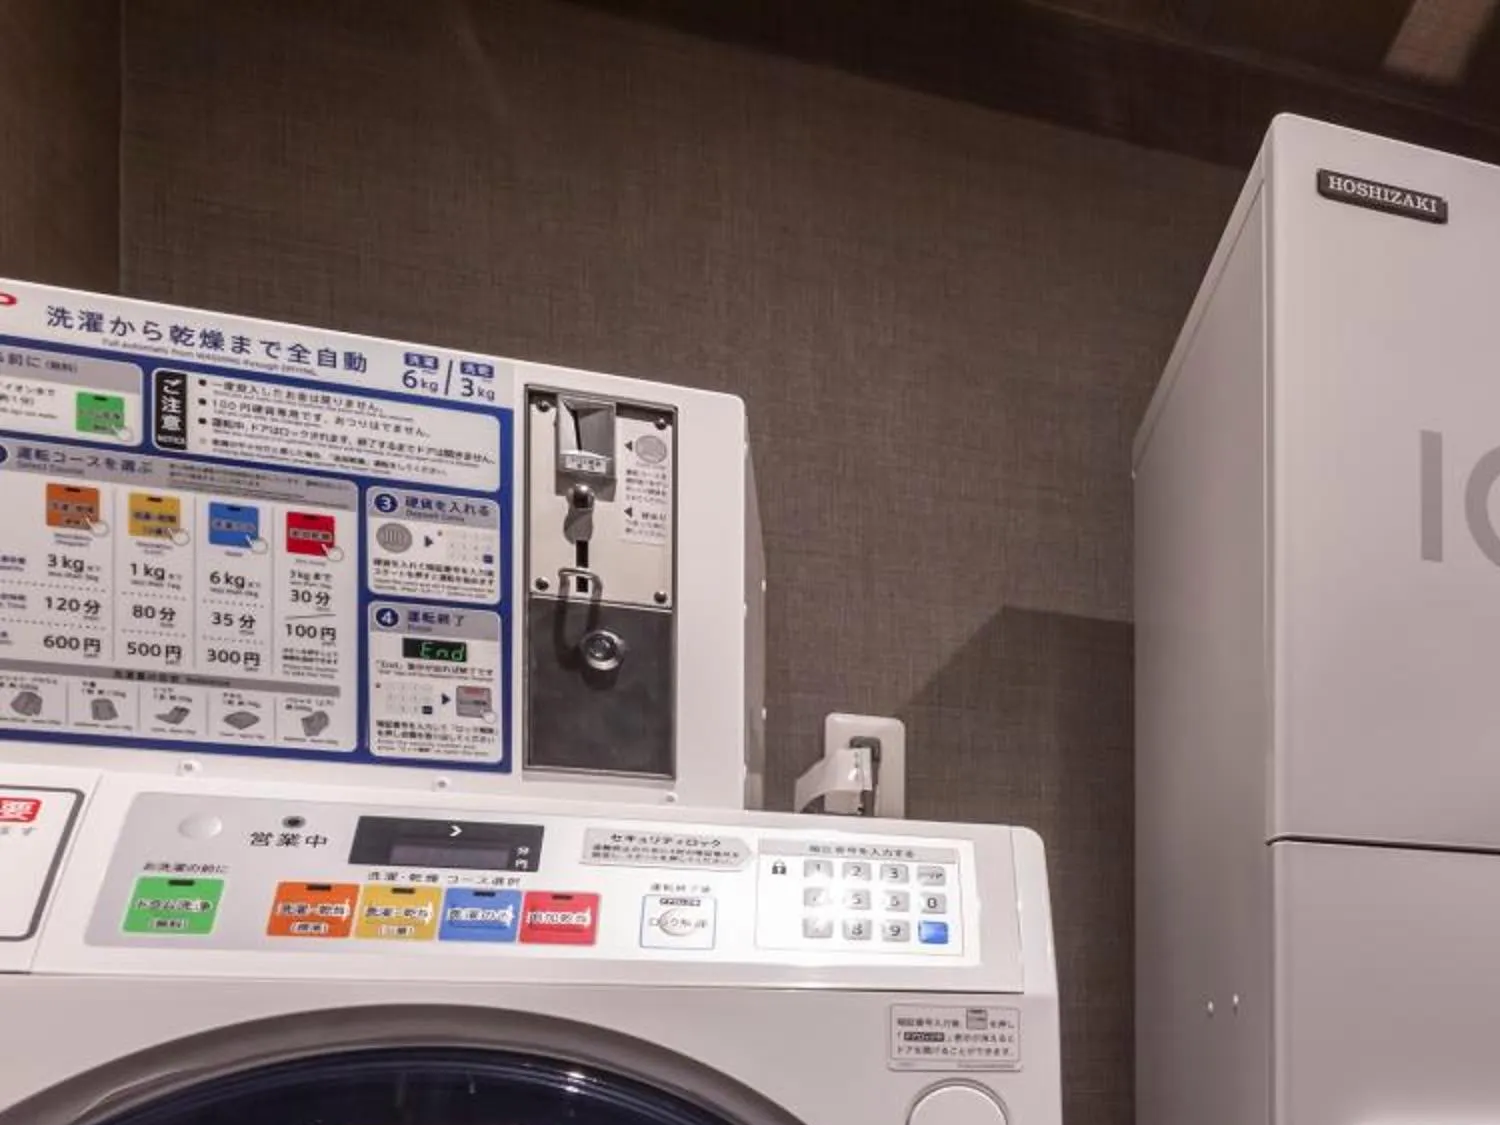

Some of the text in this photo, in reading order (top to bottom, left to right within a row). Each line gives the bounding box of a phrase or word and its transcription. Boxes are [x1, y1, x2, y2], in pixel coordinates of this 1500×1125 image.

[1327, 174, 1438, 214] HOSHIZAKI
[46, 304, 368, 374] 洗濯から乾燥まで全自動
[402, 369, 438, 393] 6kg
[460, 378, 495, 402] 3kg
[162, 378, 183, 431] ご注意
[44, 596, 101, 615] 120分
[290, 589, 331, 607] 30分
[132, 605, 176, 622] 80分
[211, 611, 256, 628] 35分
[285, 623, 337, 641] 100円
[43, 635, 101, 653] 600円
[127, 641, 183, 661] 500円
[420, 641, 465, 662] End
[207, 649, 261, 667] 300円
[250, 830, 328, 848] 営業中
